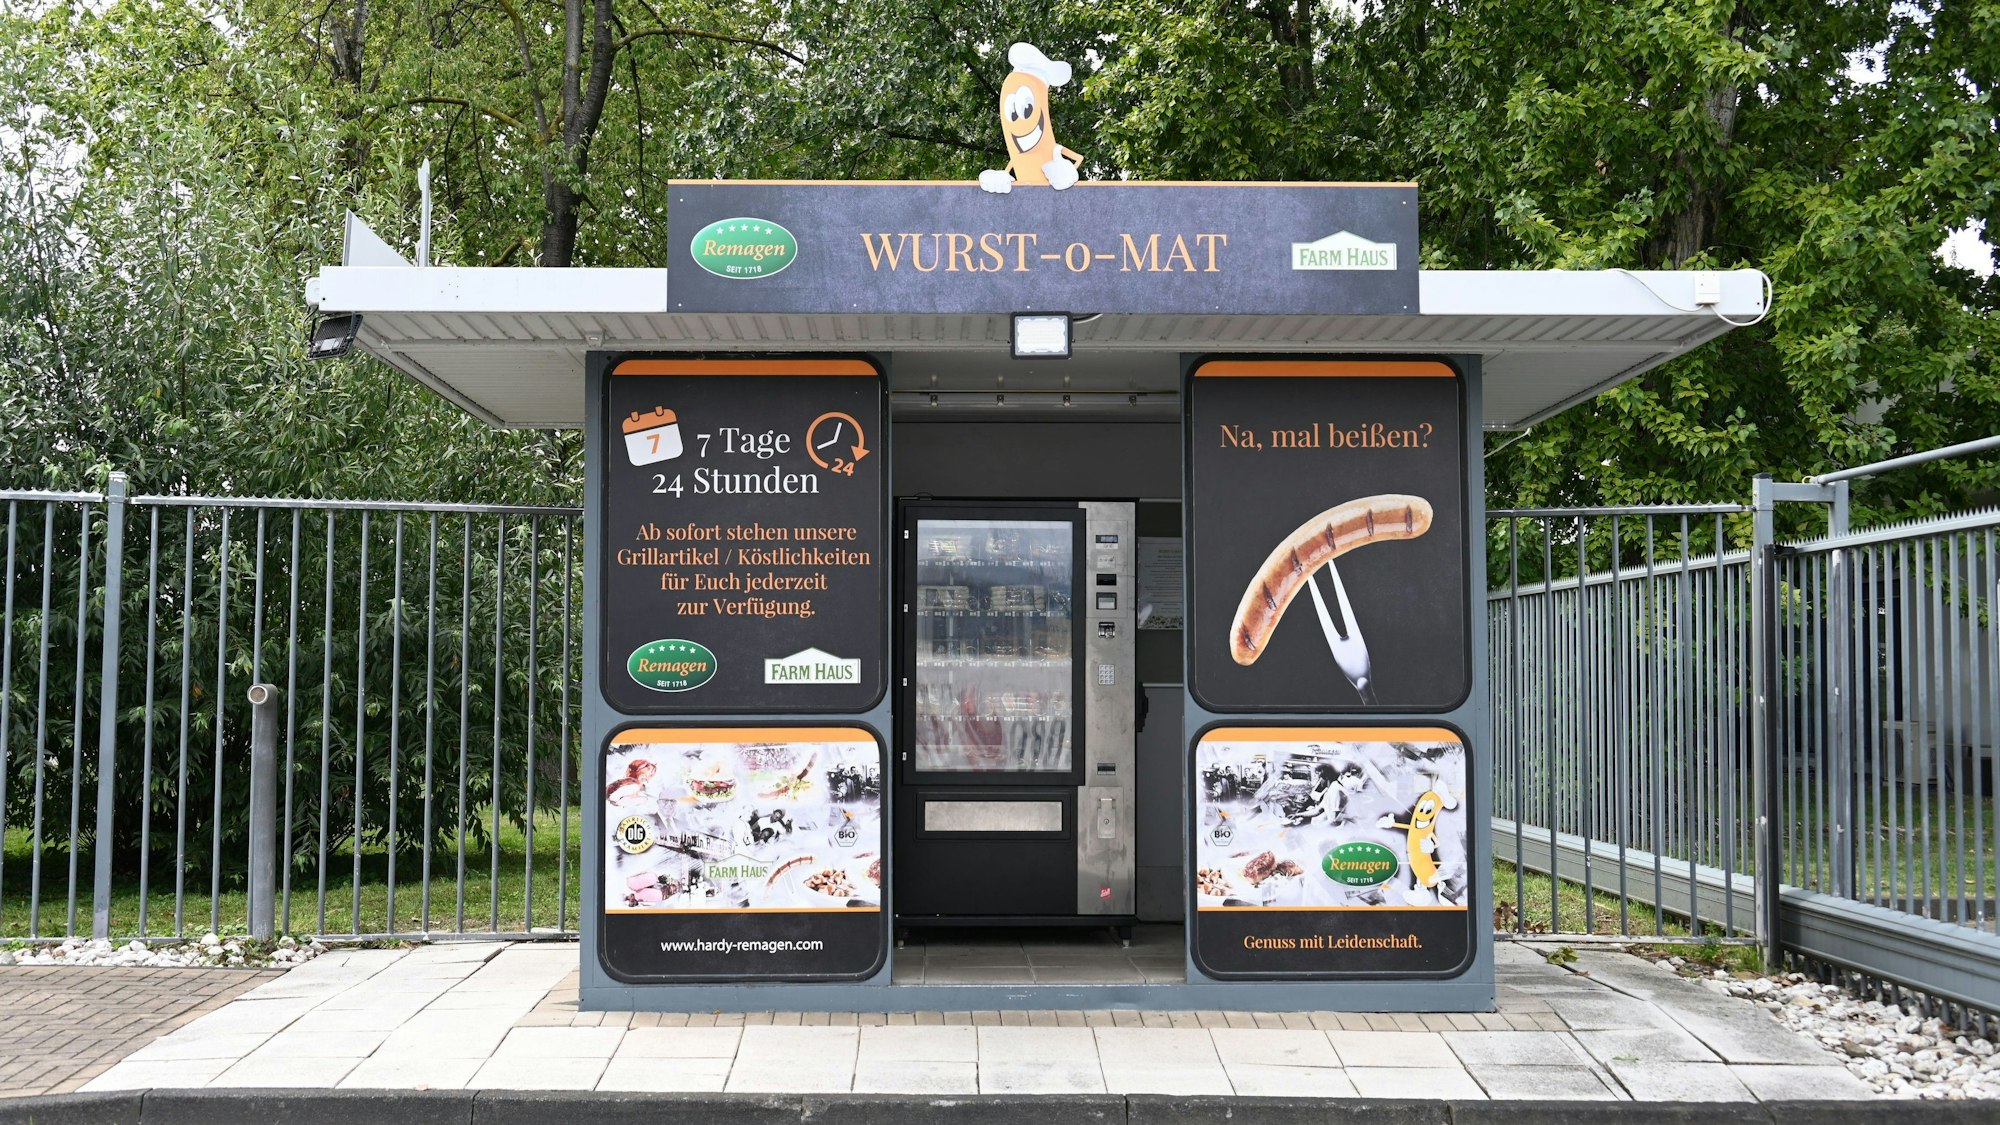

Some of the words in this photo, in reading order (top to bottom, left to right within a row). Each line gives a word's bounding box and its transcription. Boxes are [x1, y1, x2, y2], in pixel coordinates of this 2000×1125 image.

[703, 239, 785, 261] Remagen
[860, 232, 1229, 274] WURST-o-MAT
[1299, 248, 1342, 266] FARM
[1347, 248, 1388, 266] HAUS
[726, 265, 742, 274] SEIT
[744, 265, 762, 274] 1718
[646, 434, 661, 455] 7
[697, 433, 710, 457] 7
[719, 427, 791, 460] Tage
[1220, 424, 1263, 451] Na,
[1271, 423, 1321, 448] mal
[1328, 422, 1433, 449] beißen?
[830, 457, 855, 477] 24
[652, 473, 684, 498] 24
[693, 466, 820, 495] Stunden
[636, 523, 661, 541] Ab
[666, 523, 721, 541] sofort
[726, 523, 788, 541] stehen
[793, 527, 857, 541] unsere
[617, 548, 720, 566] Grillartikel
[725, 549, 732, 566] /
[738, 548, 871, 566] Köstlichkeiten
[660, 573, 689, 591] für
[694, 573, 740, 591] Euch
[744, 573, 828, 593] jederzeit
[677, 601, 708, 615] zur
[713, 597, 816, 619] Verfügung.
[638, 658, 707, 677] Remagen
[771, 664, 811, 680] FARM
[815, 663, 853, 680] HAUS
[657, 679, 670, 688] SEIT
[672, 679, 687, 688] 1718
[708, 865, 738, 878] FARM
[741, 865, 768, 878] HAUS
[1330, 858, 1390, 874] Remagen
[660, 938, 824, 954] www.hardy-remagen.com
[1244, 935, 1296, 949] Genuss
[1300, 935, 1324, 949] mit
[1328, 934, 1423, 949] Leidenschaft.
